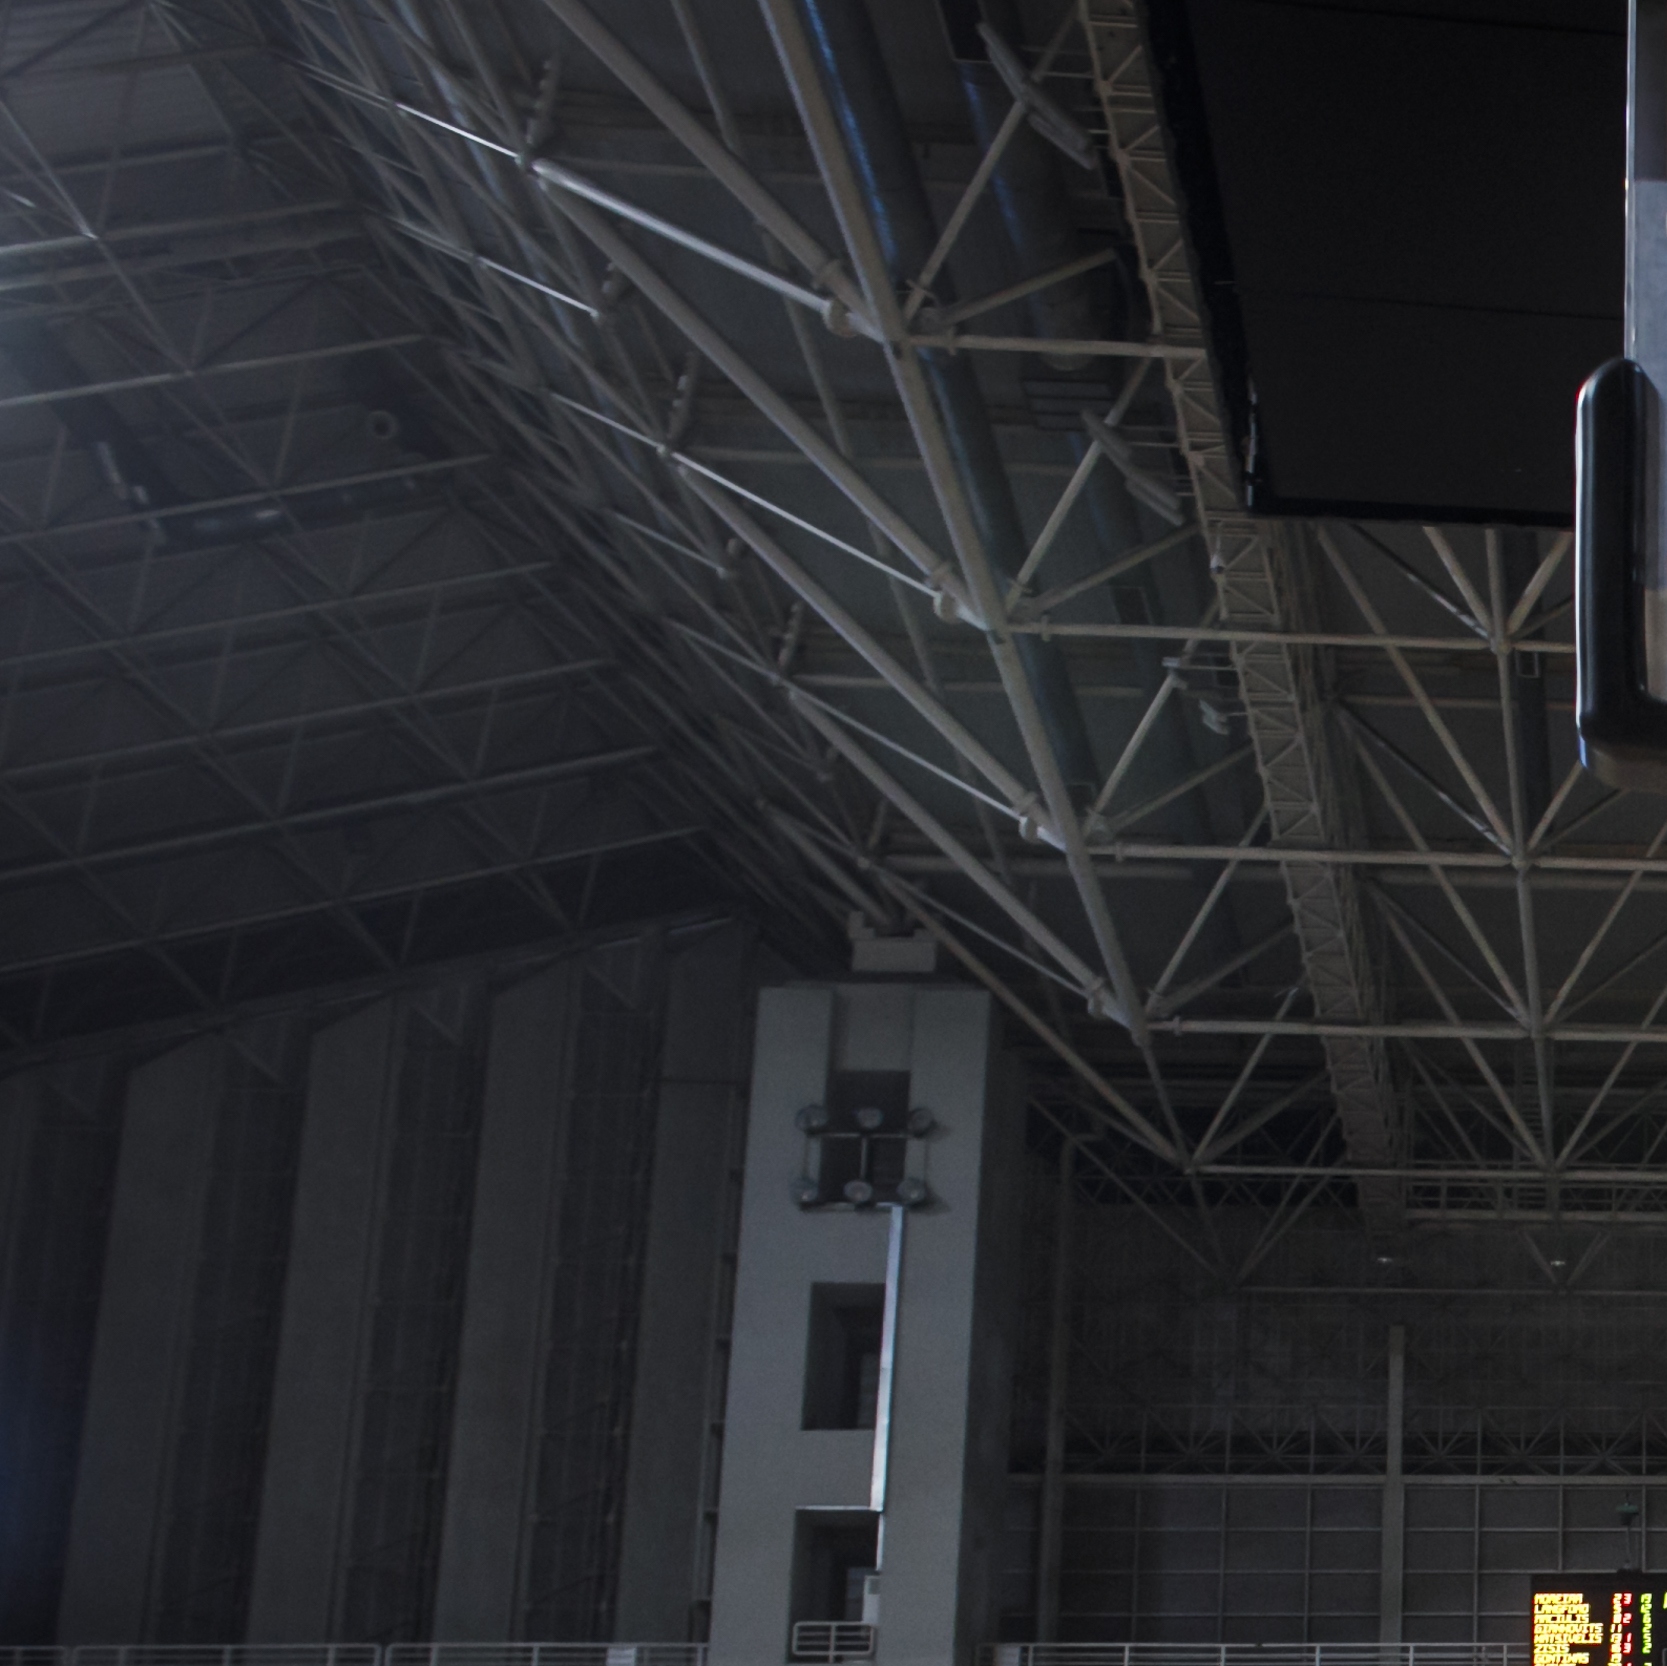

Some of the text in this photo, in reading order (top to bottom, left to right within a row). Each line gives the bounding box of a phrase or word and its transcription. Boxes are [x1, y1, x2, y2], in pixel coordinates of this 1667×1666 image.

[1623, 1592, 1632, 1604] 3
[1623, 1614, 1632, 1623] 2
[1643, 1623, 1652, 1633] 2
[1627, 1634, 1632, 1643] 1
[1534, 1644, 1570, 1654] ZISIS
[1623, 1644, 1632, 1653] 3
[1643, 1644, 1652, 1653] 2
